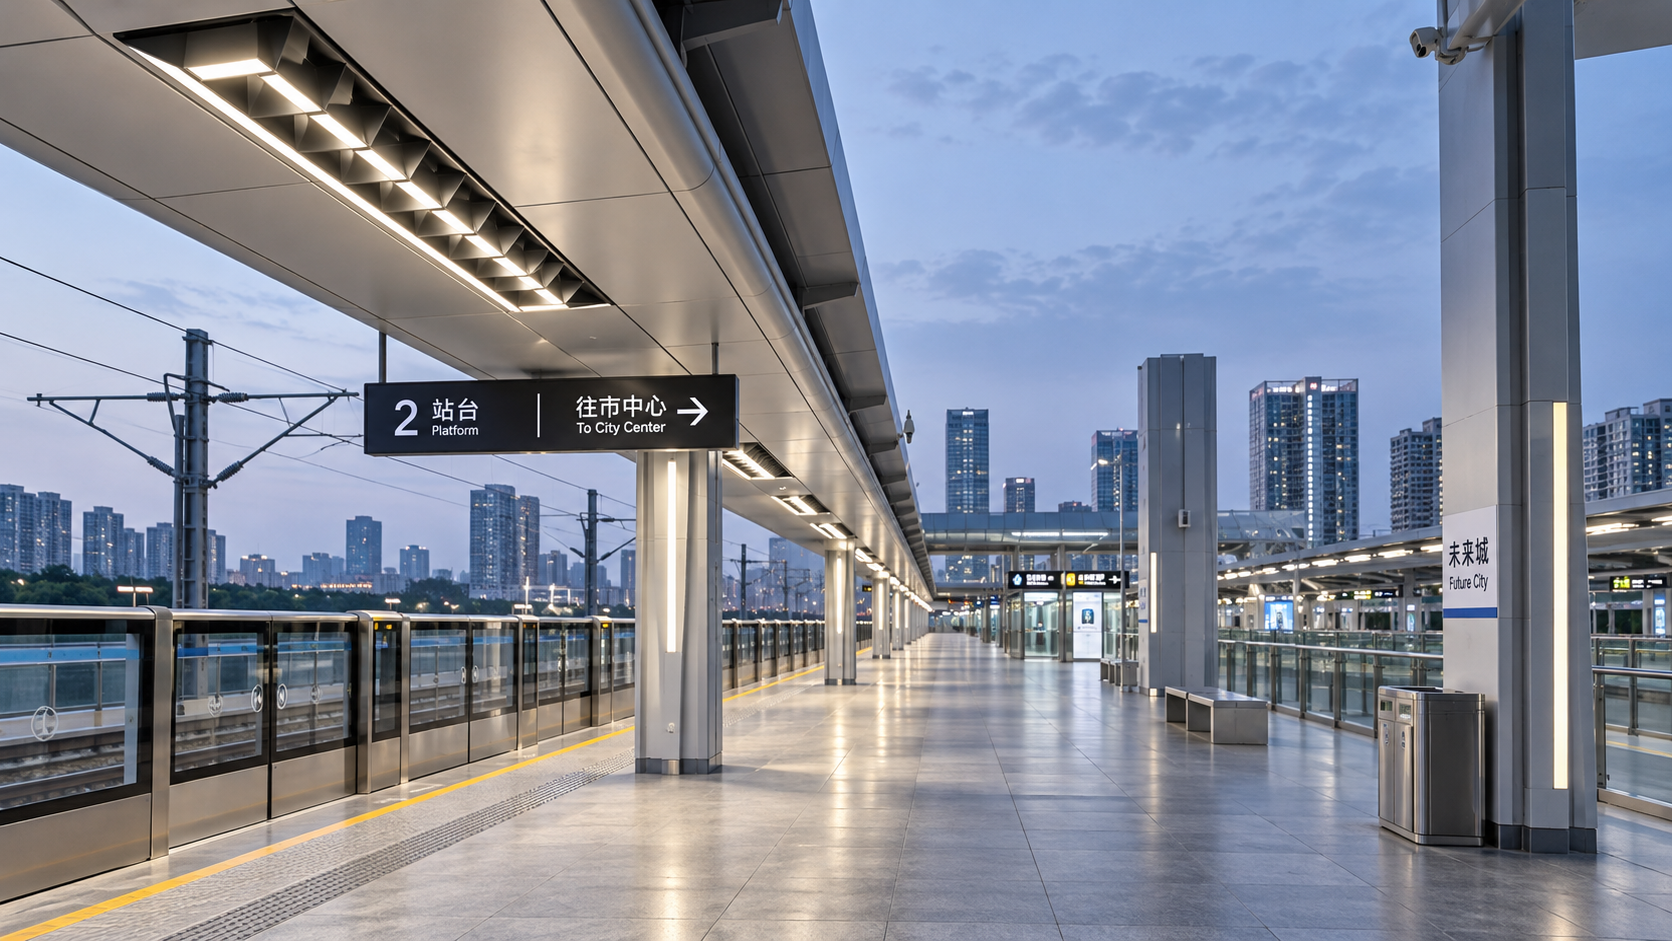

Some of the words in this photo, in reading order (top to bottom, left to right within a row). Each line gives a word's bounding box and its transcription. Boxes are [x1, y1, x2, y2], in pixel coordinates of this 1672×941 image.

[394, 398, 418, 436] 2
[431, 397, 479, 422] 站台
[575, 394, 667, 419] 往市中心
[431, 423, 479, 436] Platform
[577, 422, 593, 434] To
[595, 421, 620, 436] City
[623, 421, 667, 433] Center
[1448, 537, 1489, 568] 未来城
[1449, 576, 1471, 590] Future
[1473, 573, 1489, 592] City
